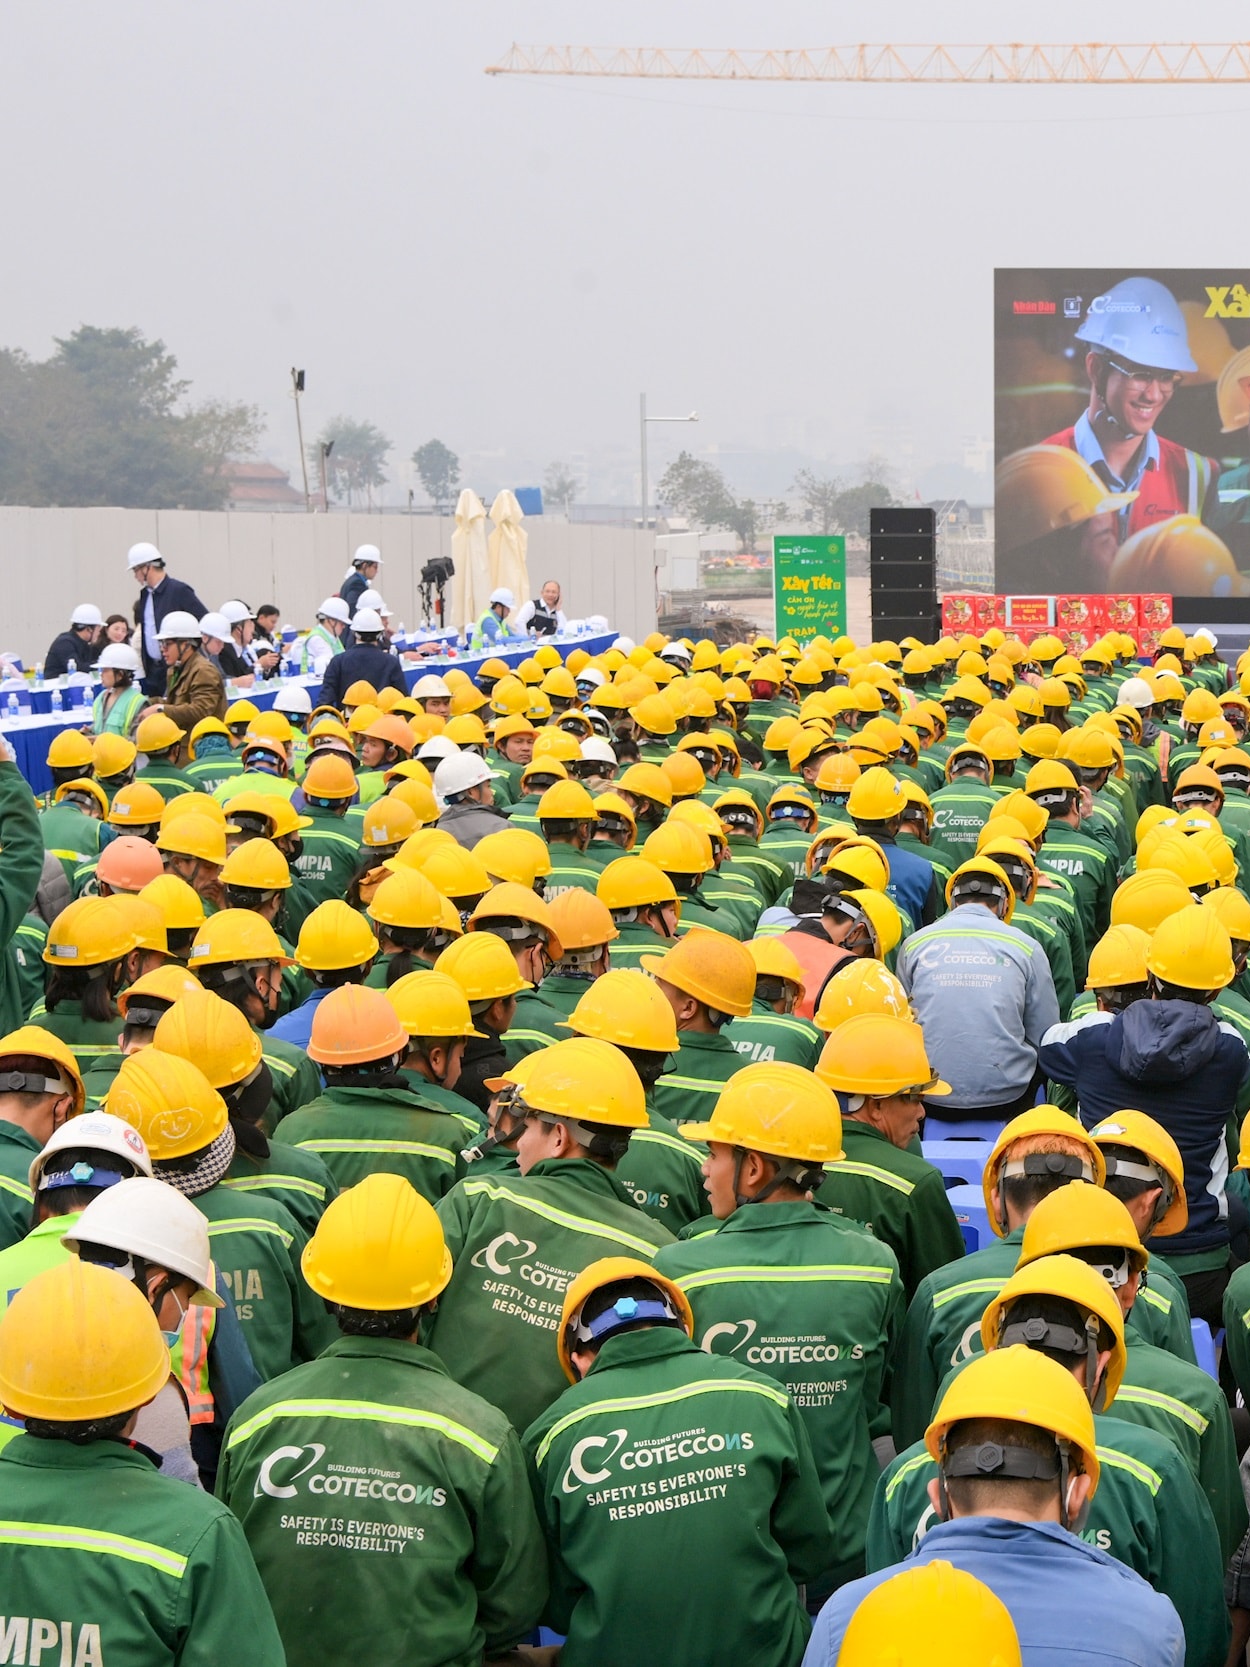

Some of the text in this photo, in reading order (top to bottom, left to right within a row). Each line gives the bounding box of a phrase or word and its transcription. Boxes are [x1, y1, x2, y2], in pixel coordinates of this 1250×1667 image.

[782, 573, 833, 594] Xây Tết
[787, 595, 802, 603] CẢM
[786, 626, 817, 638] TRẠM
[949, 818, 985, 826] COTECCO
[297, 855, 333, 871] MPIA
[1043, 859, 1084, 876] MPIA
[944, 955, 1011, 967] COTECCONS
[932, 973, 954, 981] SAFETY
[940, 980, 993, 988] RESPONSIBILITY
[535, 1261, 567, 1277] BUILDING
[482, 1279, 563, 1316] SAFETY IS EVE
[747, 1343, 864, 1364] COTECCONS
[786, 1379, 848, 1394] EVERYONE'S
[792, 1394, 835, 1407] IBILITY
[633, 1427, 706, 1449] BUILDING FUTURES
[619, 1432, 754, 1472] COTECCONS
[327, 1463, 401, 1479] BUILDING FUTURES
[308, 1474, 447, 1507] COTECCONS
[586, 1464, 747, 1507] SAFETY IS EVERYONE'S
[609, 1484, 728, 1521] RESPONSIBILITY
[280, 1515, 425, 1541] SAFETY IS EVERYONE'S
[296, 1532, 407, 1554] RESPONSIBILITY
[0, 1615, 103, 1667] MPIA
